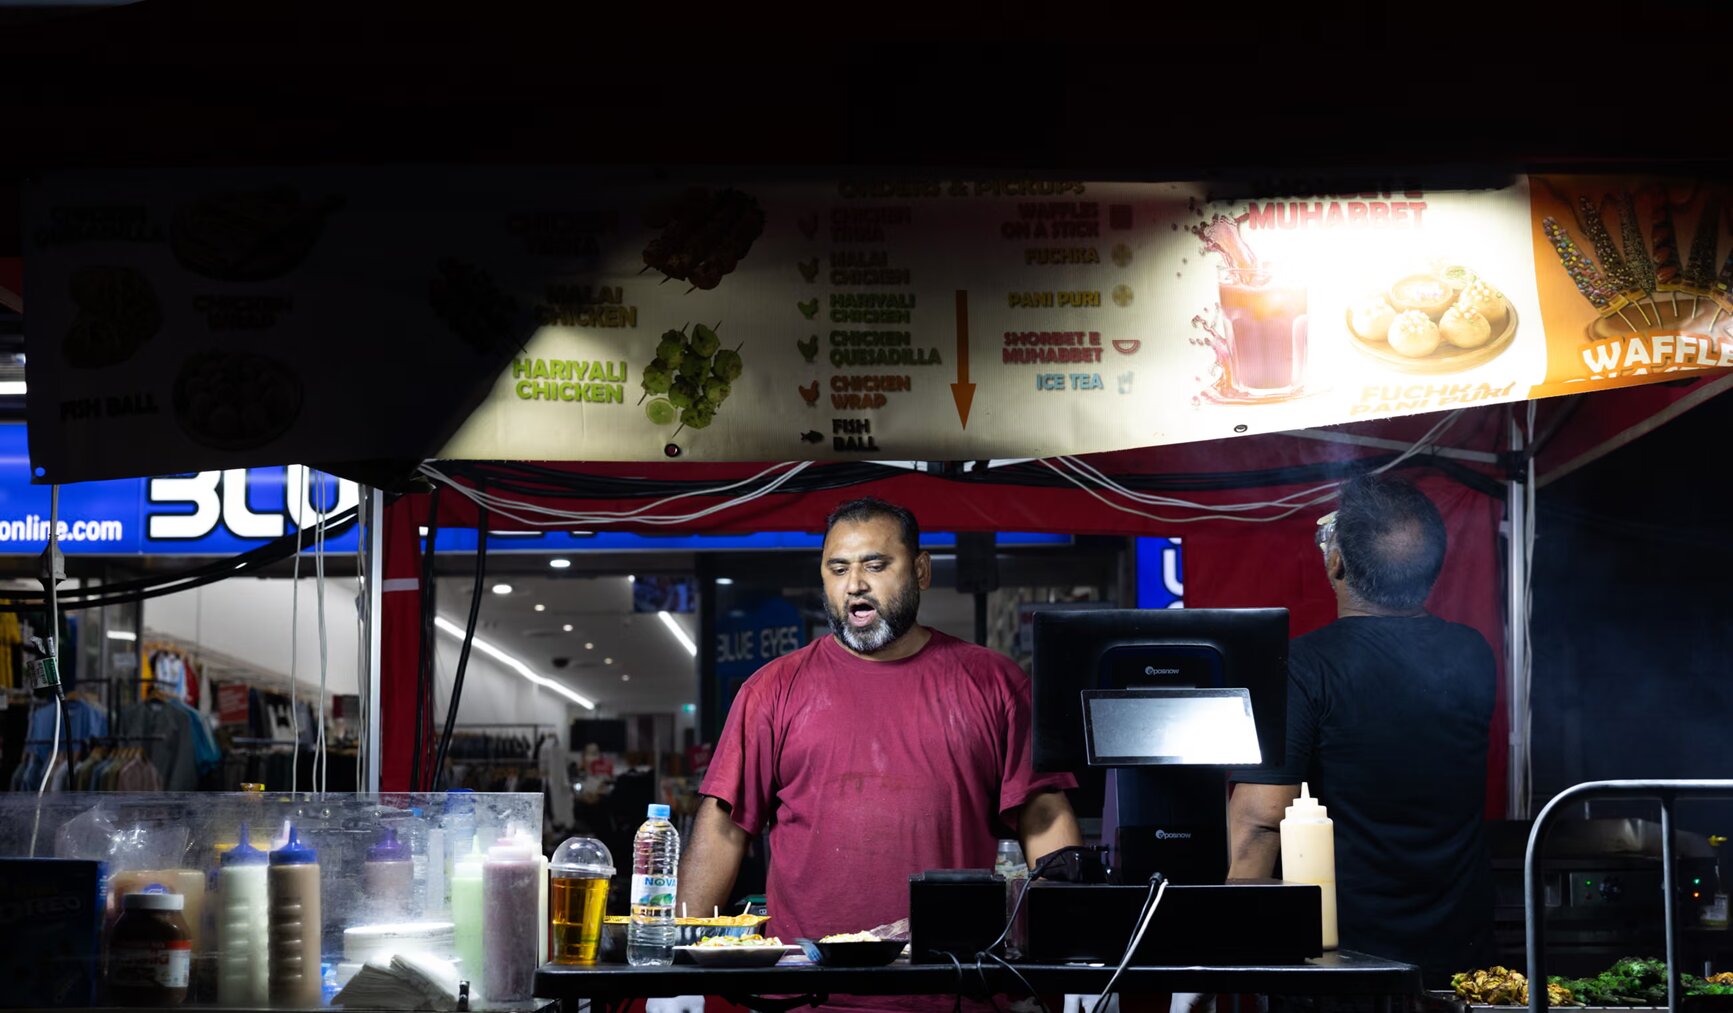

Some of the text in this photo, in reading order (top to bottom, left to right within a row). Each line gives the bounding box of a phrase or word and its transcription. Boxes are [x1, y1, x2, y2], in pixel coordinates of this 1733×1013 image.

[947, 180, 969, 197] &
[975, 178, 1086, 197] PICKUPS
[1001, 221, 1099, 239] ON A STICK
[830, 252, 888, 268] MALAI
[1024, 247, 1100, 264] FUCHKA
[830, 269, 911, 285] CHICKEN
[830, 293, 916, 309] HARIYALI
[1008, 291, 1101, 307] PANI PURI
[830, 308, 911, 324] CHICKEN
[829, 330, 911, 347] CHICKEN
[1004, 331, 1101, 346] SHORBET E
[829, 347, 942, 367] QUESADILLA
[1002, 347, 1104, 364] MUHABBET
[512, 358, 627, 382] HARIYALI
[830, 375, 911, 392] CHICKEN
[1036, 374, 1104, 390] ICE TEA
[516, 381, 624, 403] CHICKEN
[831, 392, 888, 410] WRAP
[832, 418, 870, 434] FISH
[832, 435, 880, 451] BALL
